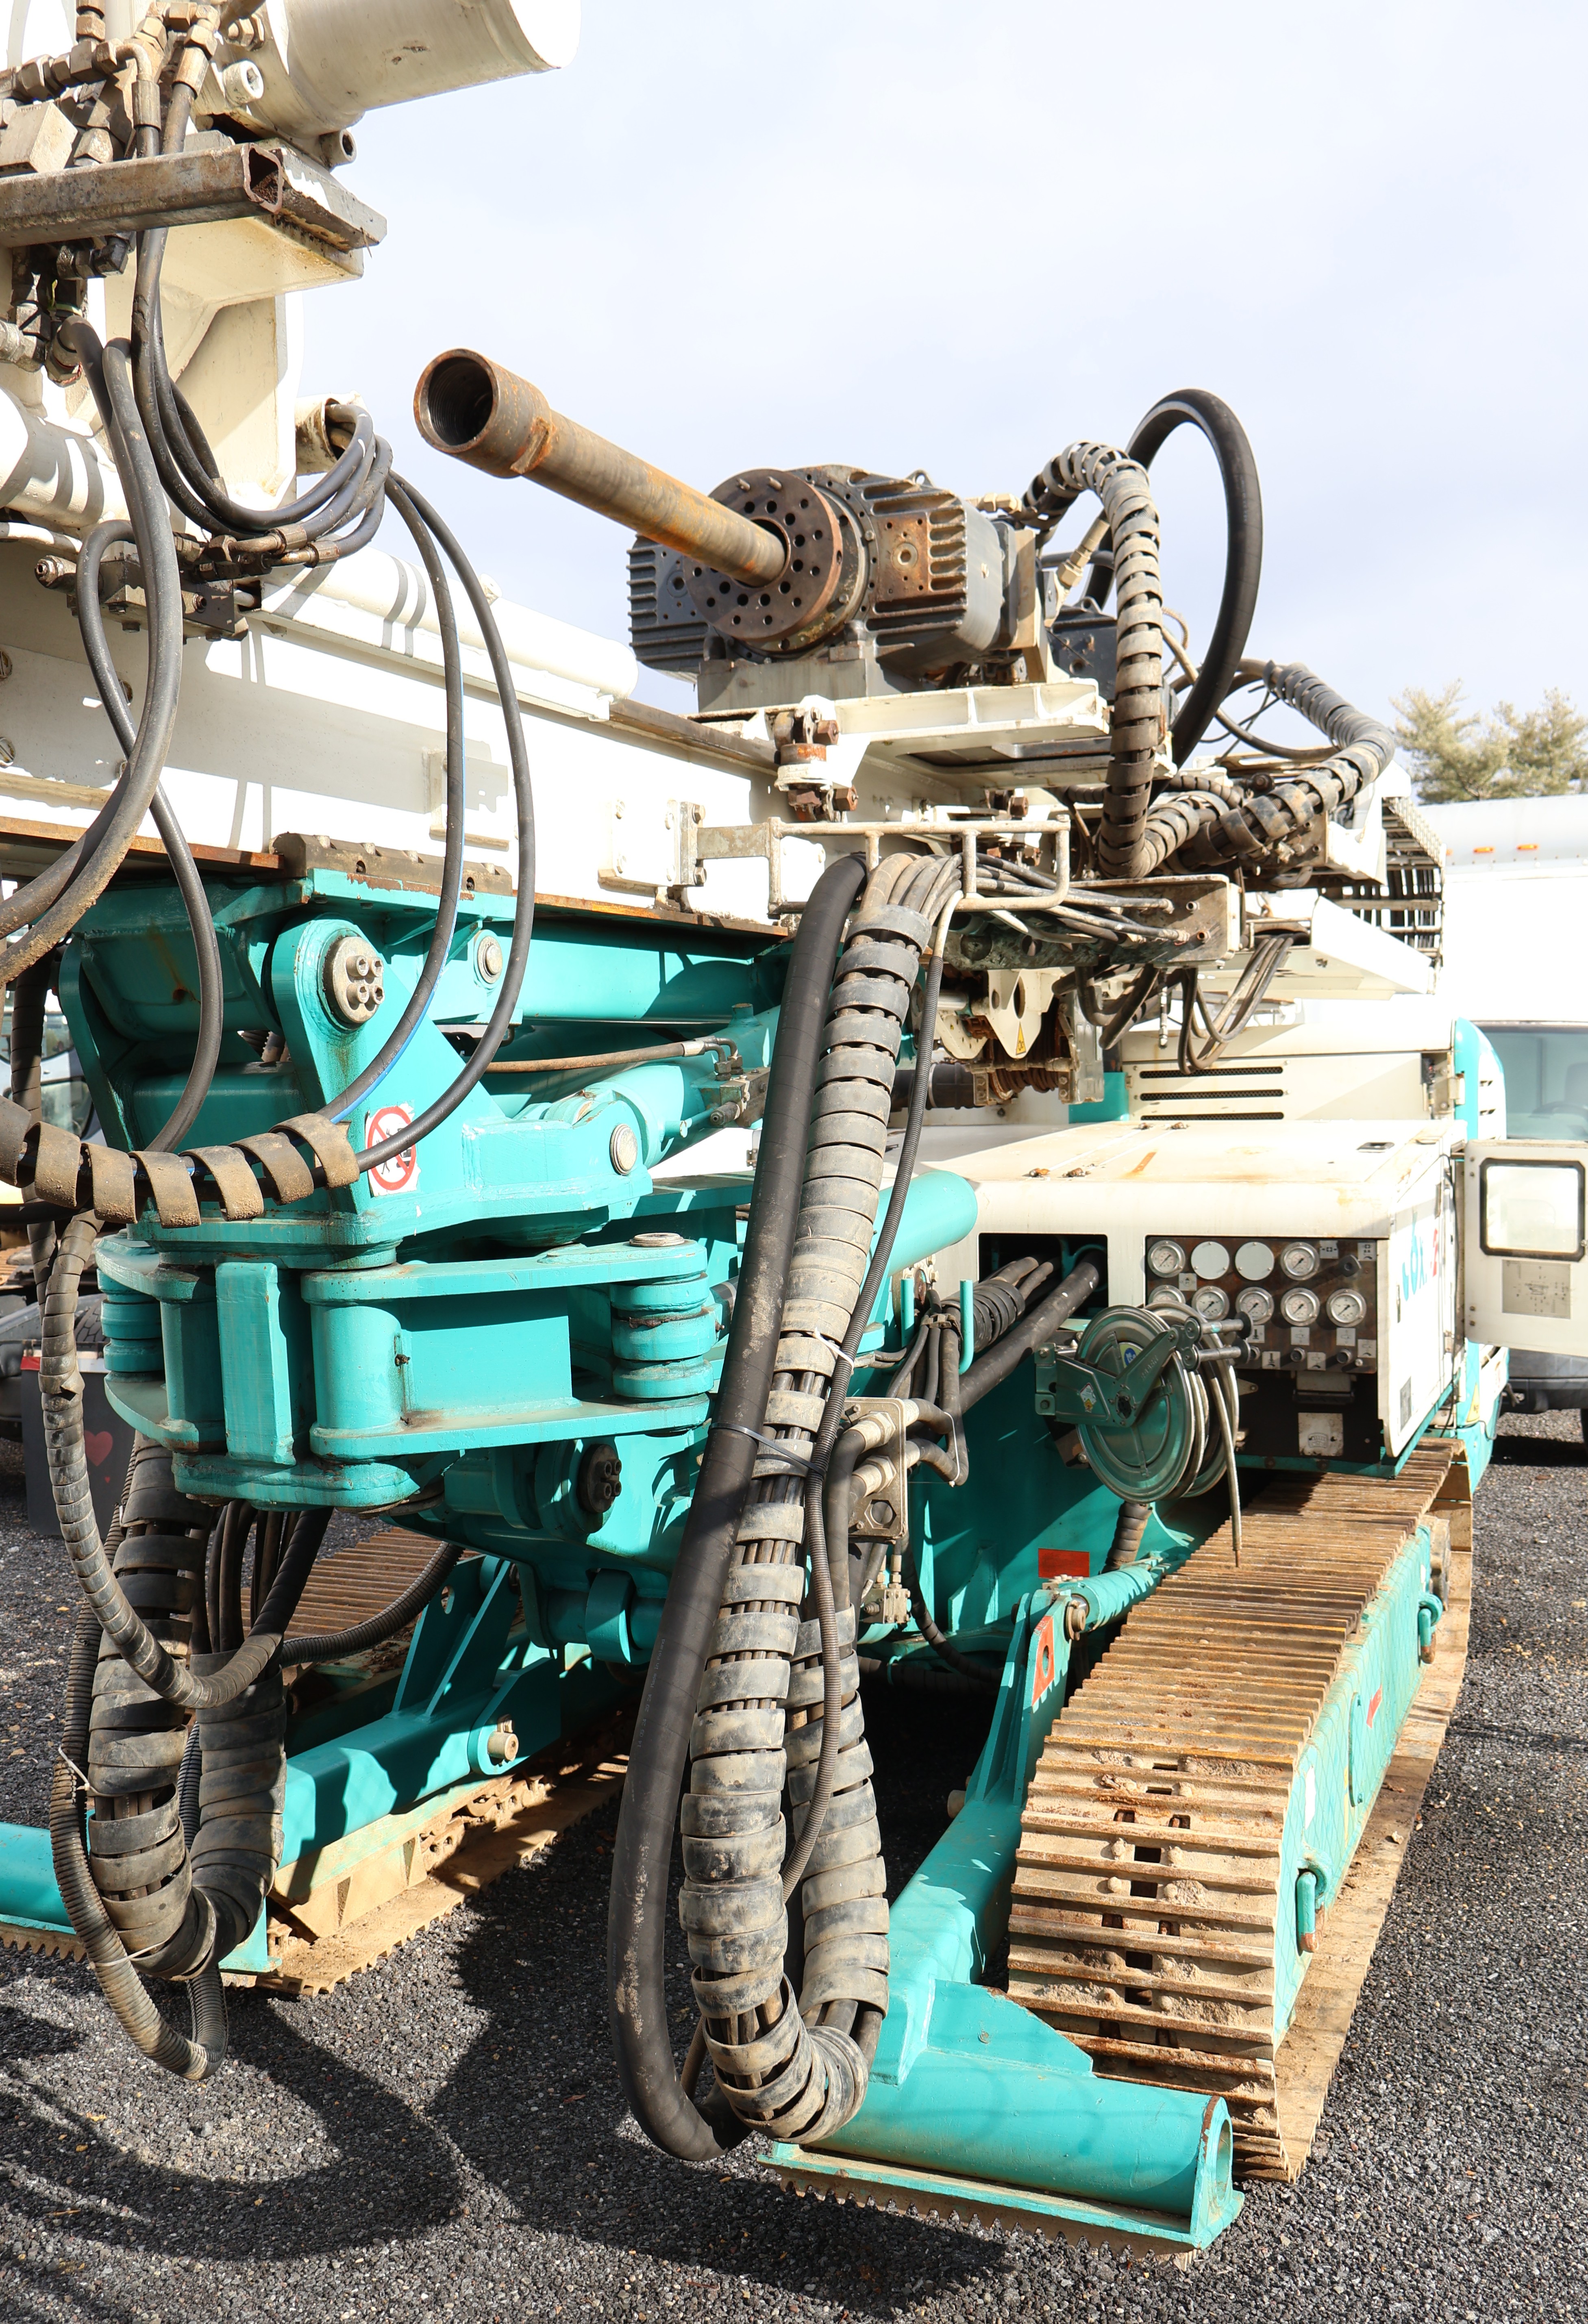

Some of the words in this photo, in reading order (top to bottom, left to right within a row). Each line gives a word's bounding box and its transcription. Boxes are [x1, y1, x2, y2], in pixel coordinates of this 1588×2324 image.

[656, 1638, 666, 1660] Poland
[646, 1693, 653, 1702] 24
[644, 1703, 650, 1712] 20
[641, 1718, 647, 1727] 24
[639, 1728, 645, 1738] 05
[637, 1739, 643, 1748] 14
